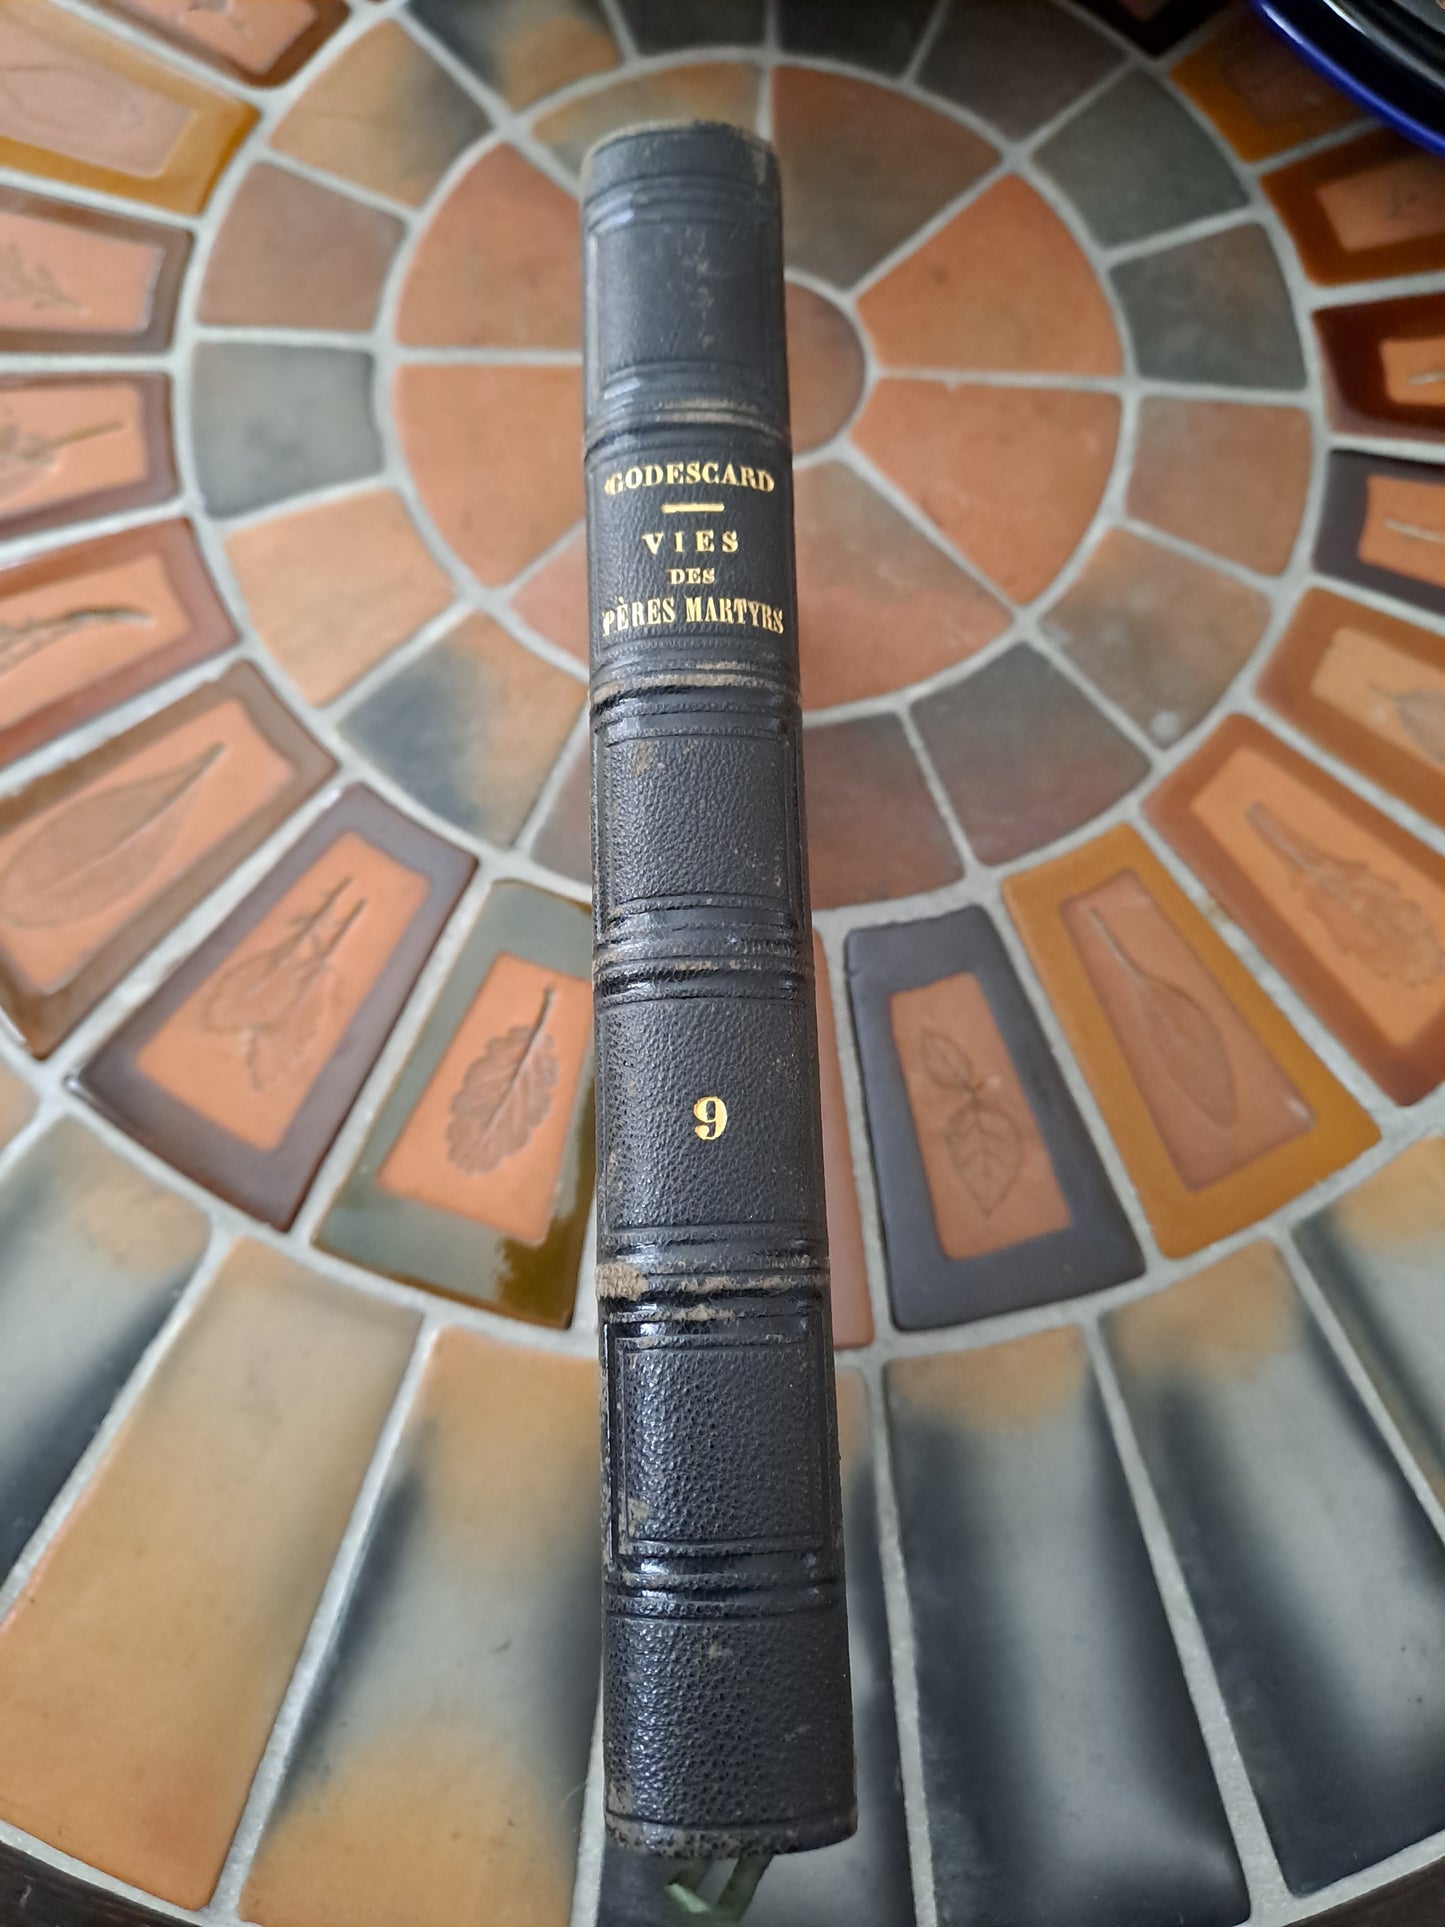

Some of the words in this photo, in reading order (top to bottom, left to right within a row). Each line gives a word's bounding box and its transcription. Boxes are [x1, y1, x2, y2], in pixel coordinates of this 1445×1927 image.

[604, 461, 775, 495] GODESCARD
[641, 529, 739, 555] VIES
[668, 567, 715, 585] DES
[602, 596, 676, 637] PÈRES
[685, 596, 784, 635] MARTYRS
[693, 1096, 727, 1140] 9
